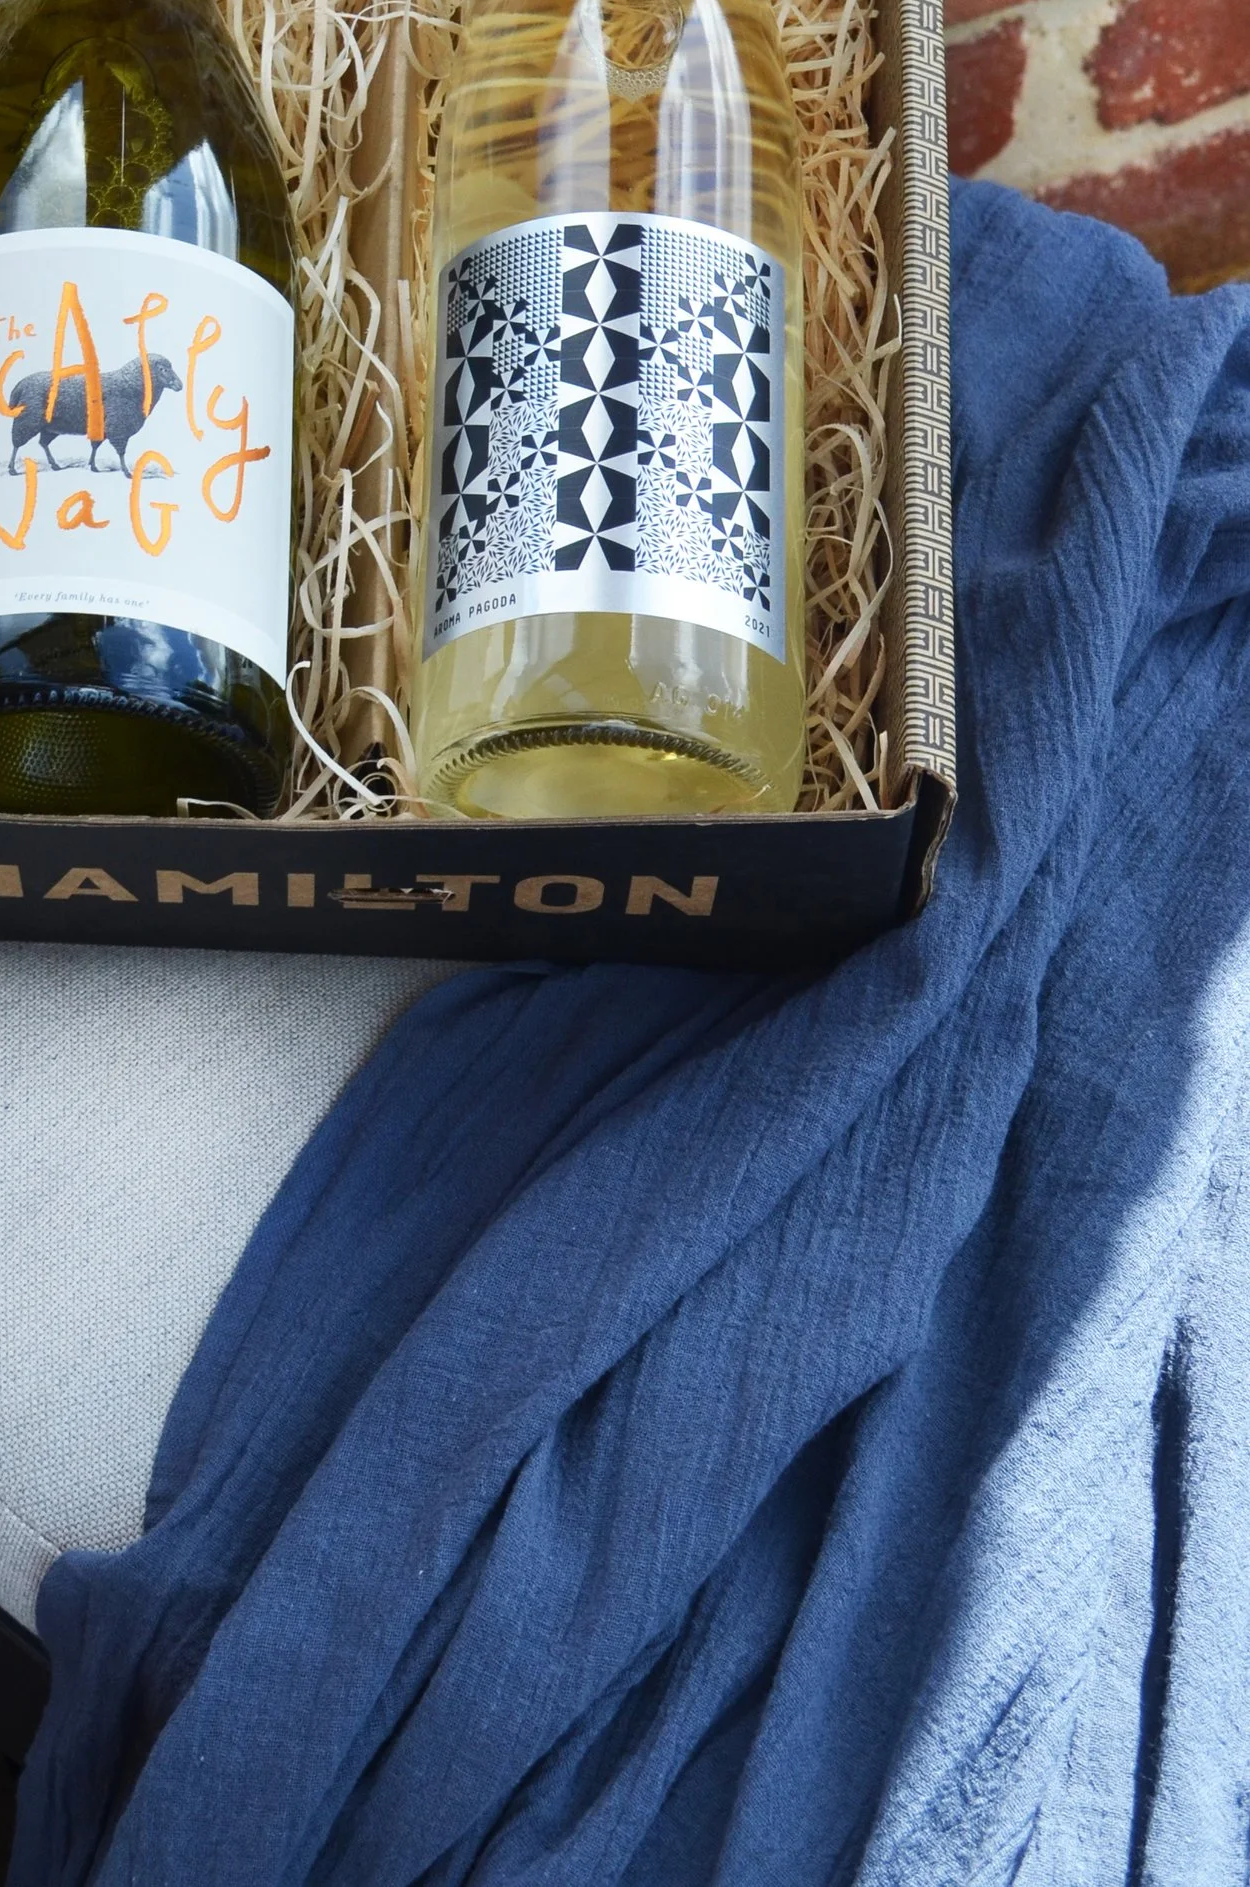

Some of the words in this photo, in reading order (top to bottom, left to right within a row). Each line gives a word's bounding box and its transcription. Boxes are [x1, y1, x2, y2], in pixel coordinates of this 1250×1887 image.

[54, 591, 96, 604] family
[98, 592, 120, 604] has
[433, 612, 461, 640] AROMA
[468, 593, 517, 619] PAGODA
[744, 614, 771, 639] 2021
